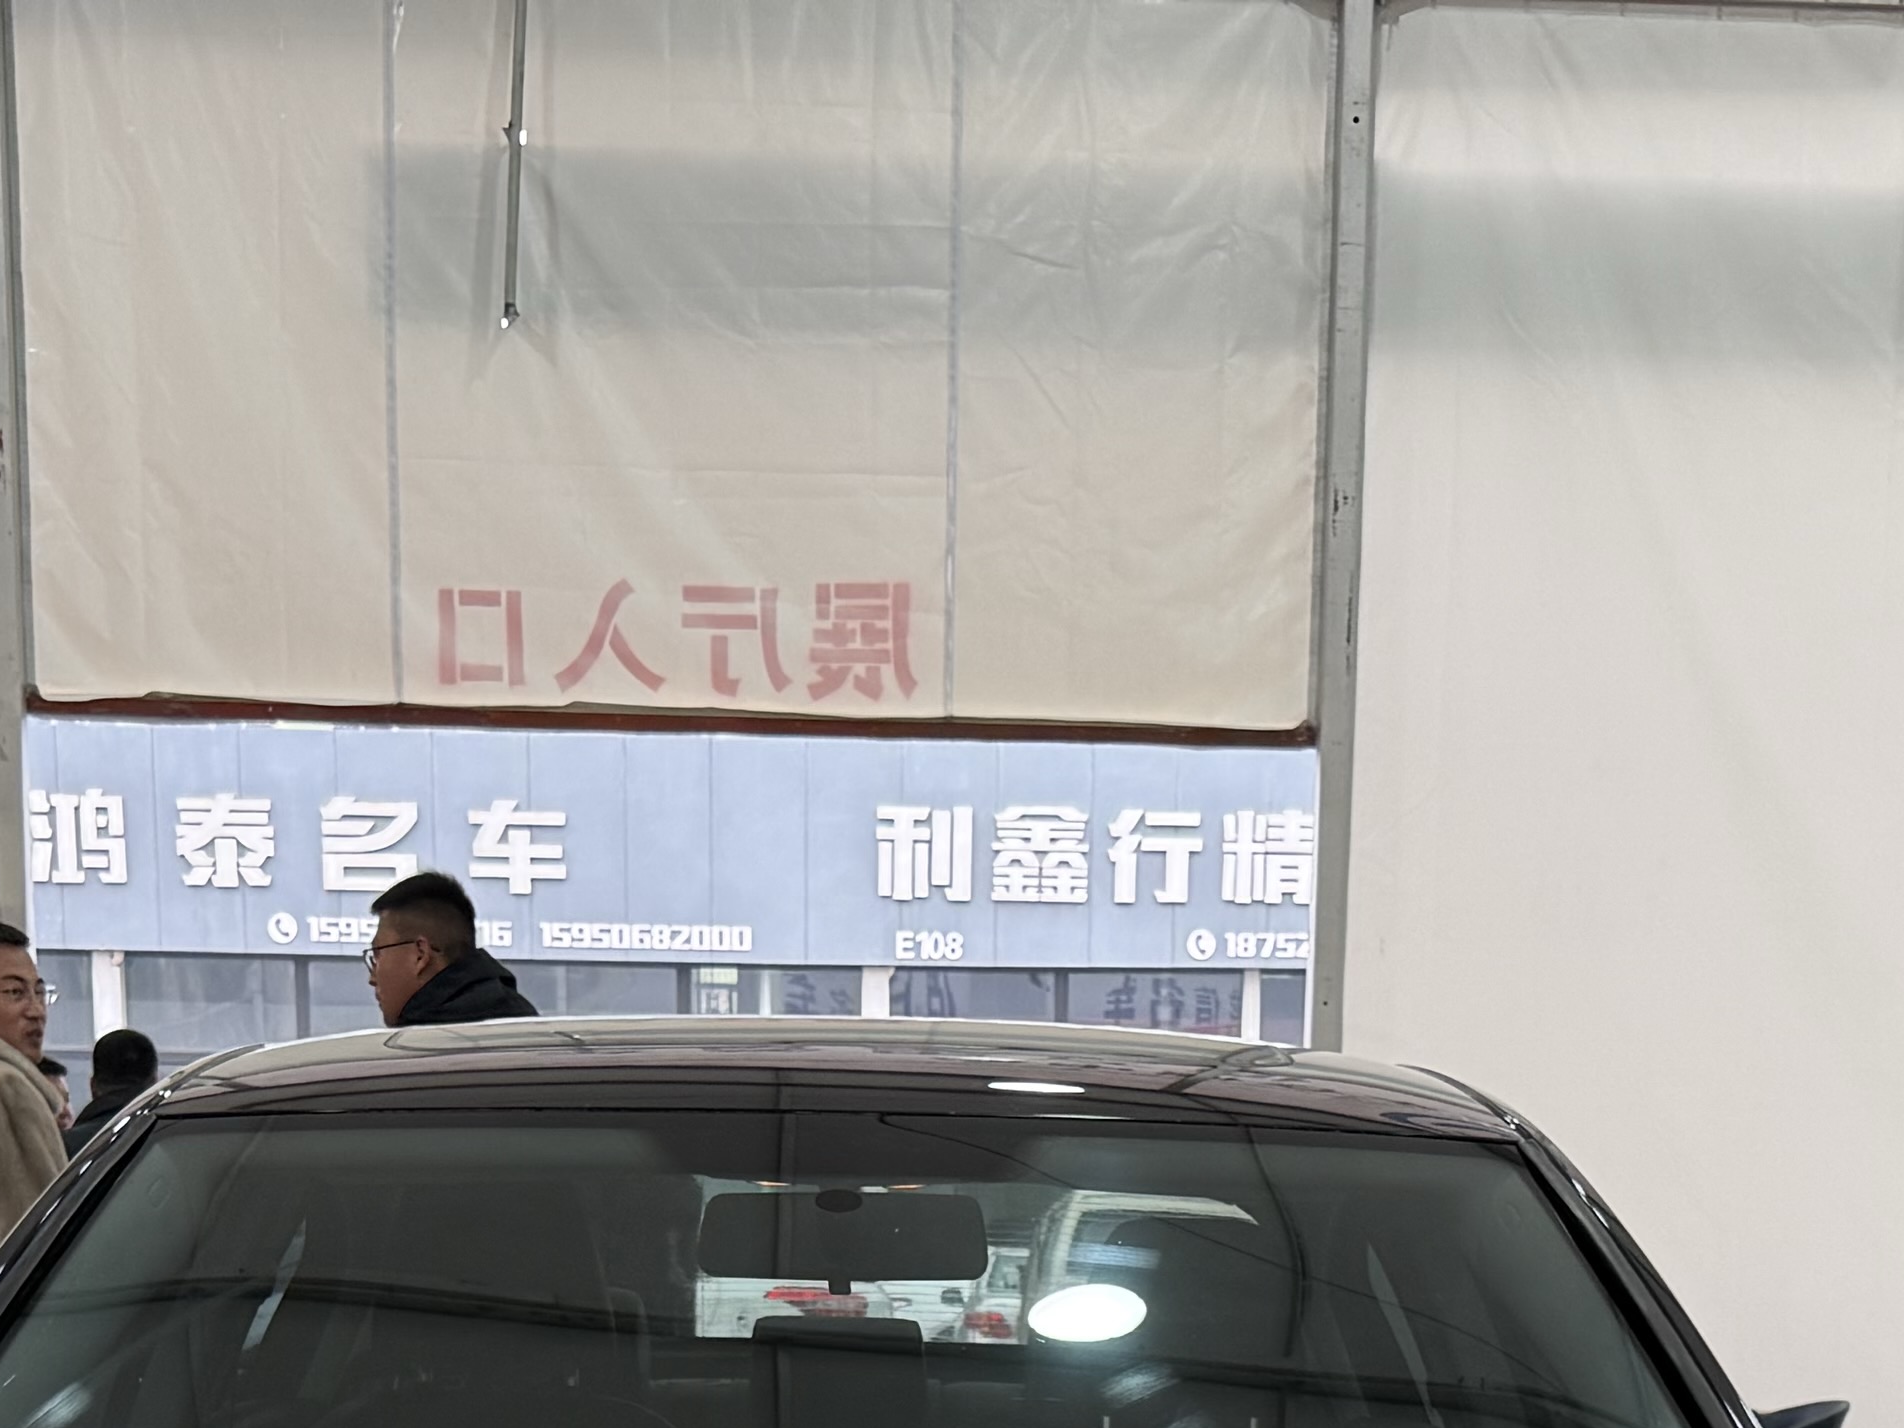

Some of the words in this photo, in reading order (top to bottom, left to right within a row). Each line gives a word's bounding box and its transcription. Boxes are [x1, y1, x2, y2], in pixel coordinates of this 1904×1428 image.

[28, 787, 567, 895] 鸿泰名车
[875, 804, 1314, 905] 利鑫行精
[306, 915, 513, 947] 159516
[539, 920, 753, 952] 15950682000
[895, 929, 965, 961] E108
